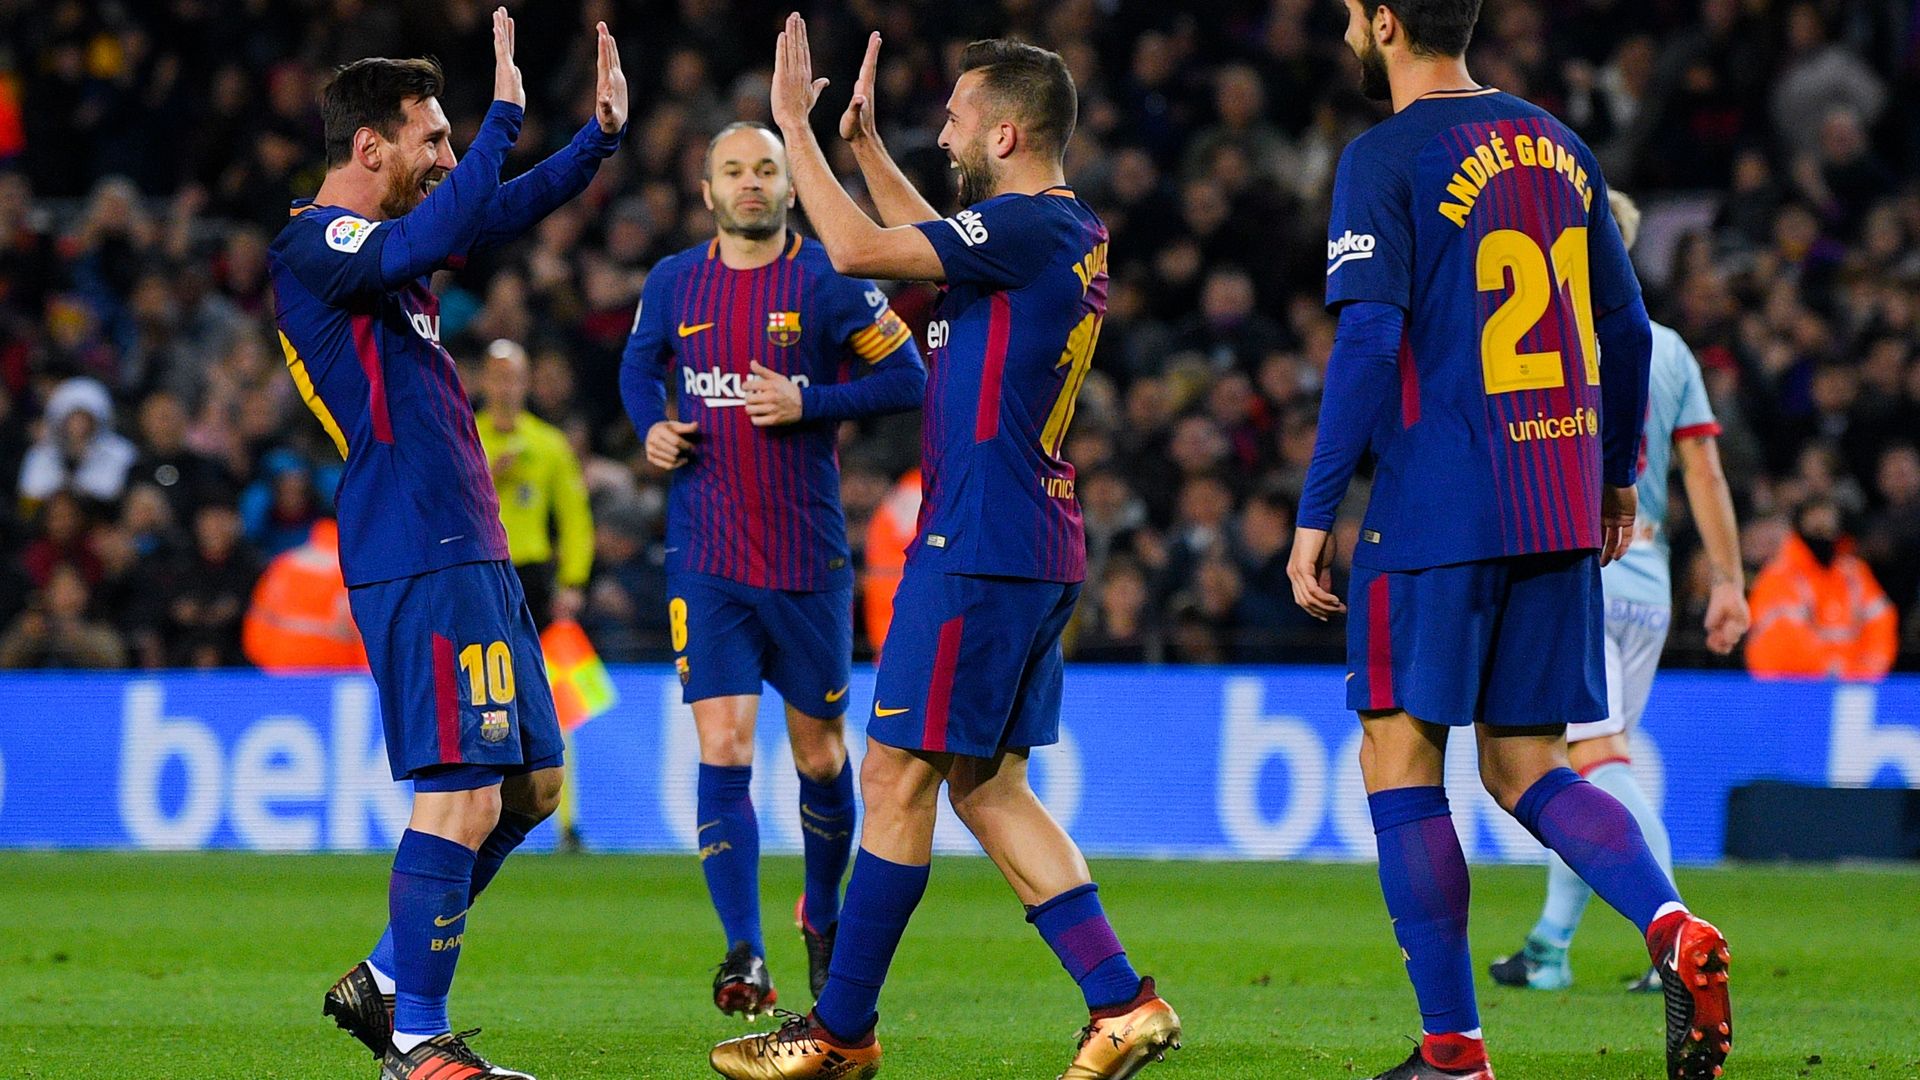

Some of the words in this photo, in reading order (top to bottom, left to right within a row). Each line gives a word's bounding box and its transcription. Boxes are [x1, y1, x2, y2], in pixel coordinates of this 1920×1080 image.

[1438, 131, 1514, 228] ANDRÉ
[956, 210, 988, 244] eko
[1475, 227, 1600, 395] 21
[1509, 407, 1585, 442] unicef
[1041, 477, 1074, 499] unic
[670, 597, 687, 652] 8
[459, 641, 515, 706] 10
[119, 680, 412, 851] bek
